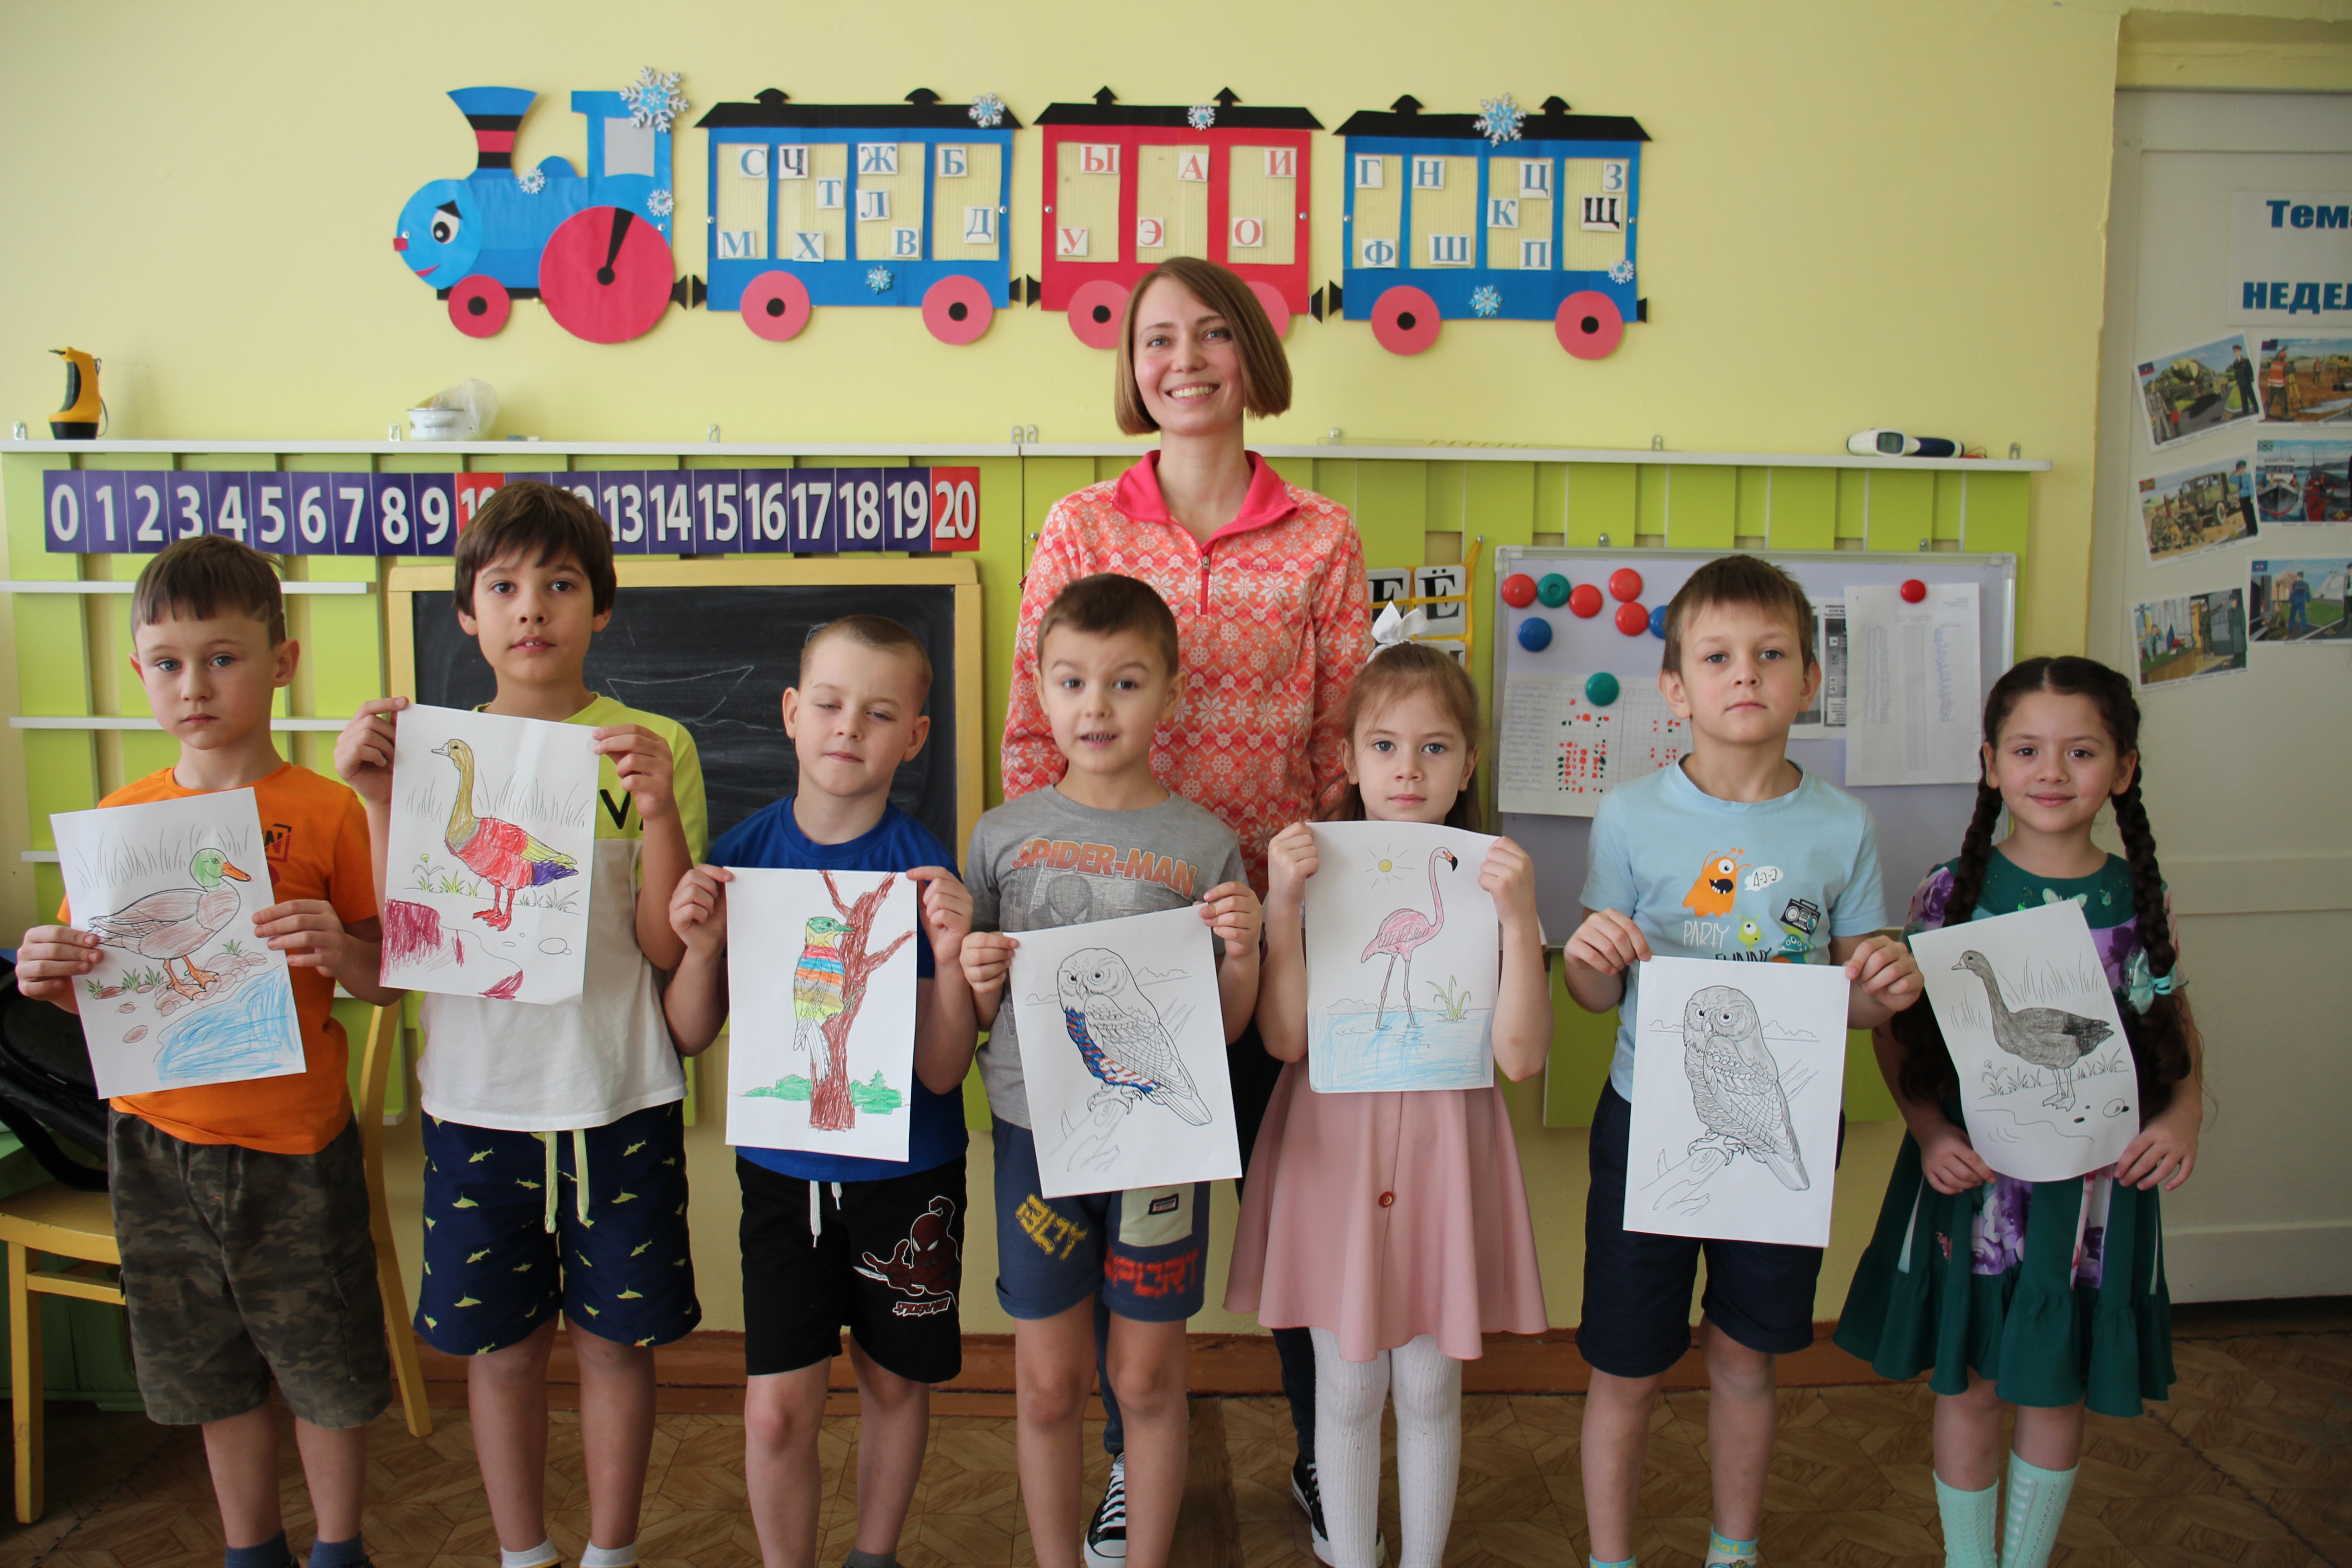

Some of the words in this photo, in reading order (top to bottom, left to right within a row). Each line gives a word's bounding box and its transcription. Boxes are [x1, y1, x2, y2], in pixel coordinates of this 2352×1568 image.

[741, 149, 764, 176] С
[783, 149, 803, 176] Ч
[860, 146, 897, 172] Ж
[943, 150, 964, 175] Б
[1082, 146, 1117, 172] Ы
[1181, 155, 1204, 180] А
[1268, 150, 1293, 176] И
[1360, 159, 1381, 186] Г
[1416, 161, 1441, 187] Н
[1524, 164, 1548, 196] Ц
[818, 180, 841, 206] Т
[861, 191, 887, 218] Л
[1491, 198, 1514, 226] К
[1584, 197, 1619, 229] Щ
[2266, 201, 2352, 228] Тем
[721, 232, 751, 257] М
[796, 233, 822, 259] Х
[896, 230, 916, 255] В
[966, 209, 992, 240] Д
[1061, 229, 1086, 254] У
[1140, 219, 1162, 245] Э
[1234, 220, 1260, 245] О
[1364, 241, 1393, 265] Ф
[1433, 236, 1467, 261] Ш
[1524, 242, 1548, 267] П
[51, 485, 79, 542] 0
[96, 486, 115, 542] 1
[135, 485, 163, 542] 2
[176, 486, 203, 540] 3
[218, 487, 247, 542] 4
[261, 487, 285, 543] 5
[299, 487, 326, 544] 6
[339, 488, 364, 544] 7
[381, 487, 409, 544] 8
[421, 487, 450, 544] 9
[603, 485, 644, 543] 13
[650, 485, 691, 541] 14
[698, 484, 738, 541] 15
[745, 483, 787, 540] 16
[792, 483, 832, 540] 17
[839, 482, 880, 539] 18
[887, 482, 928, 539] 19
[935, 481, 976, 538] 20
[1418, 569, 1459, 620] Ё
[1010, 838, 1198, 899] SPIDER-MAN
